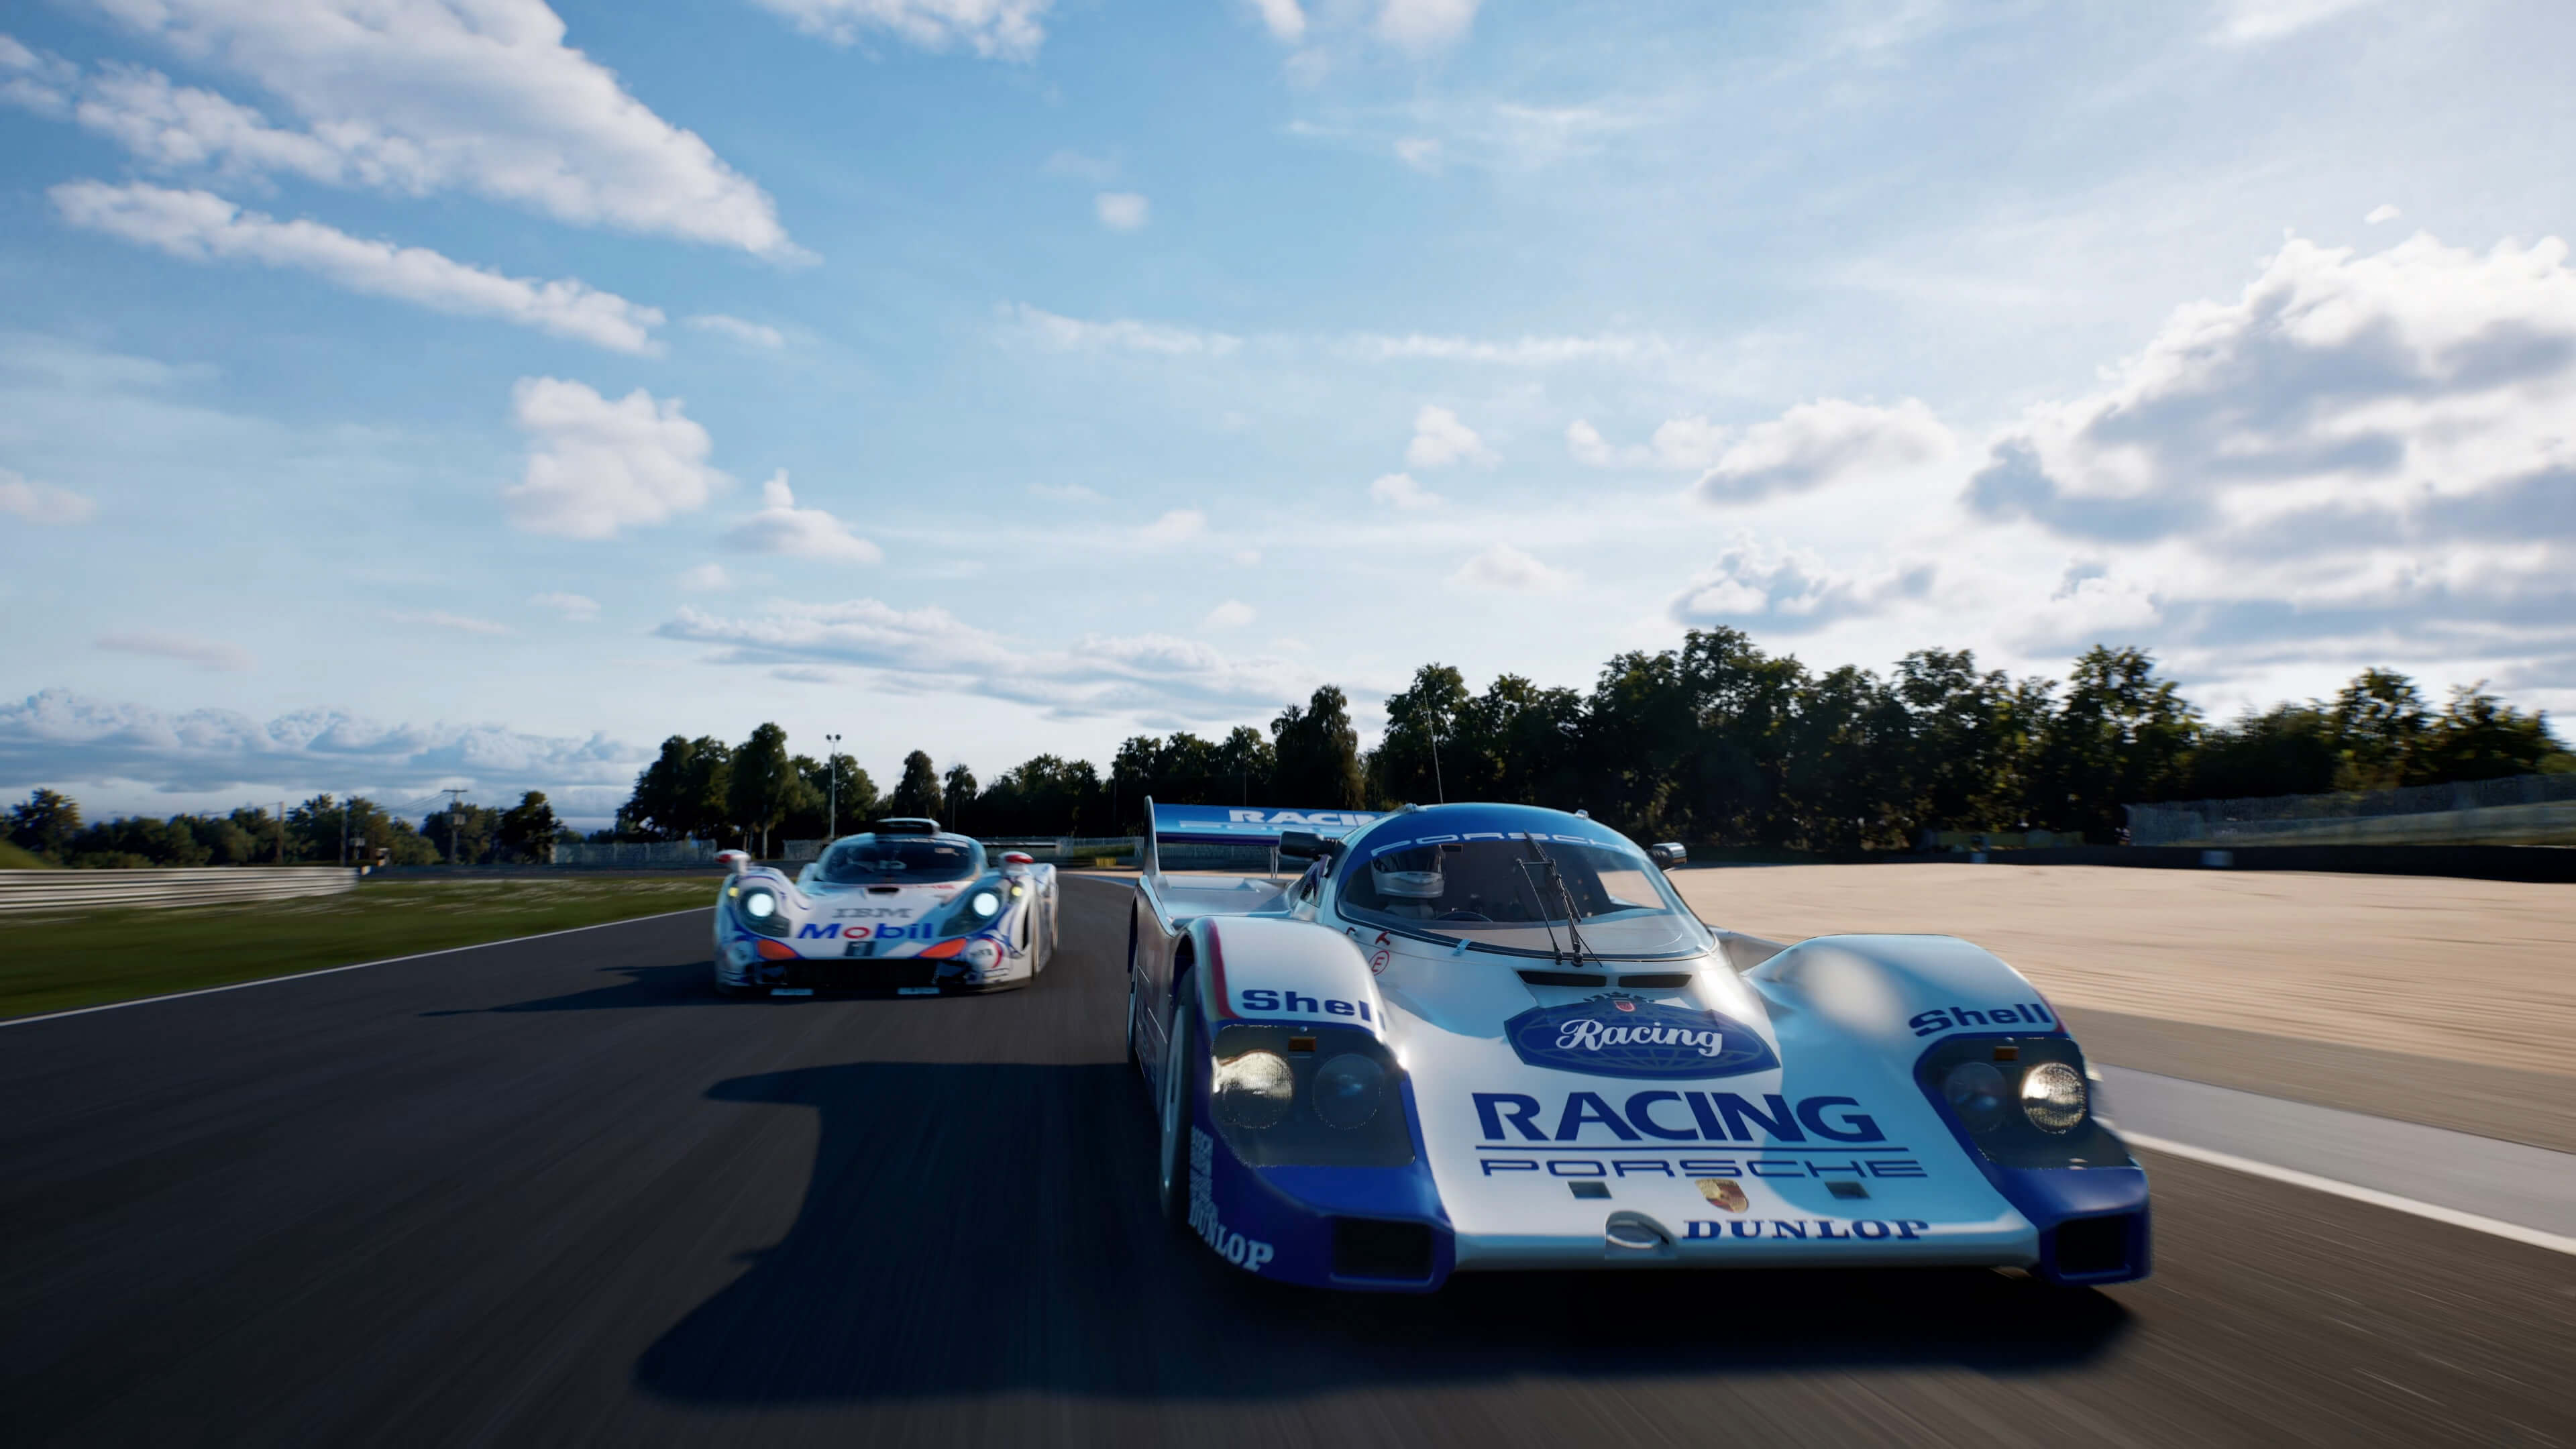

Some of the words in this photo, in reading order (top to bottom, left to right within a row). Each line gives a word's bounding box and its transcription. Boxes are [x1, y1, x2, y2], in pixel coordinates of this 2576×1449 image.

[1371, 832, 1641, 858] PORSCH
[831, 908, 913, 918] IBM
[797, 922, 933, 939] Mobil
[1242, 989, 1387, 1031] Shell
[1908, 1004, 2053, 1037] Shell
[1555, 1018, 1723, 1057] Racing
[1472, 1090, 1887, 1143] RACING
[1479, 1159, 1929, 1178] PORSCHE
[1681, 1219, 1931, 1240] DUNLOP
